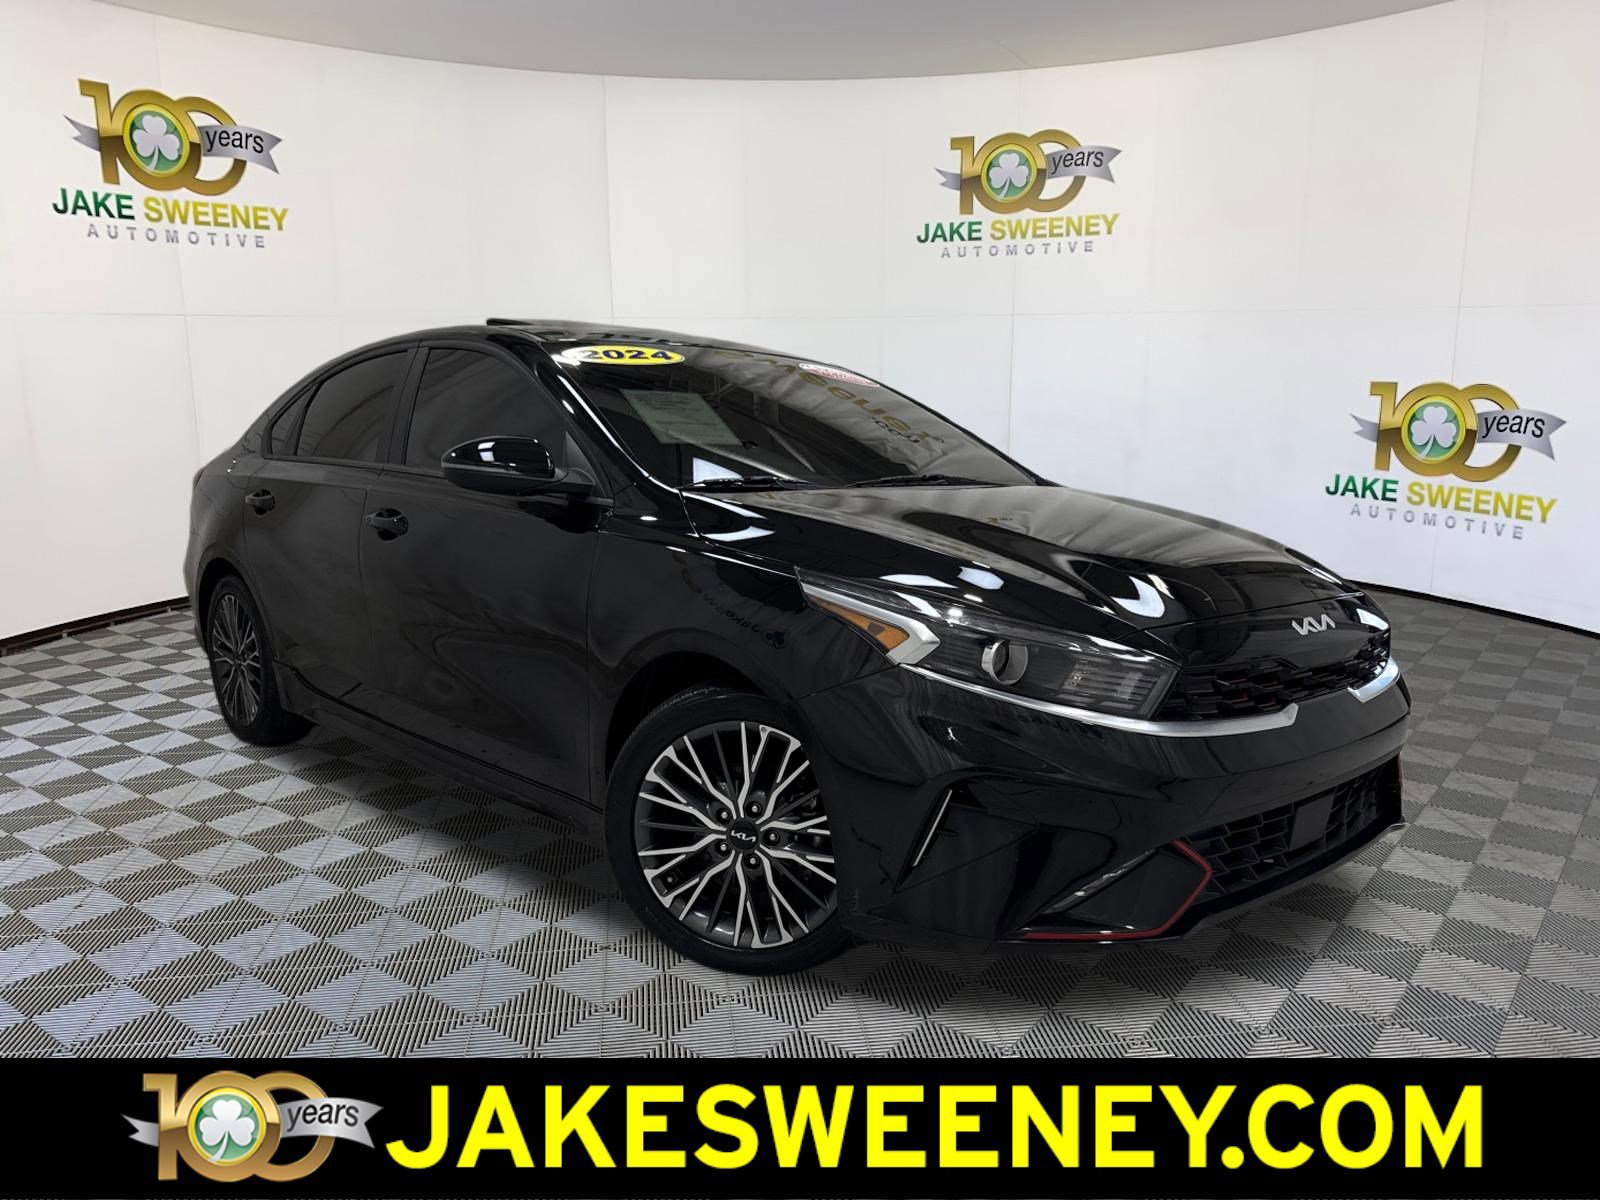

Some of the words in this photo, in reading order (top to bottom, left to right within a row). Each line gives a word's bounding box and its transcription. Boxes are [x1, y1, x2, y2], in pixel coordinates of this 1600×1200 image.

[78, 78, 248, 196] 100
[205, 128, 265, 154] years
[950, 128, 1087, 215] 100
[1051, 150, 1105, 175] years
[51, 187, 136, 221] JAKE
[143, 196, 289, 232] SWEENEY
[916, 220, 983, 243] JAKE
[989, 212, 1121, 241] SWEENEY
[86, 223, 266, 249] AUTOMOTIVE
[940, 240, 1095, 258] AUTOMOTIVE
[582, 349, 673, 361] 2024
[1370, 381, 1522, 482] 100
[1482, 415, 1546, 439] years
[1325, 474, 1399, 502] JAKE
[1406, 481, 1558, 524] SWEENEY
[1350, 503, 1524, 540] AUTOMOTIVE
